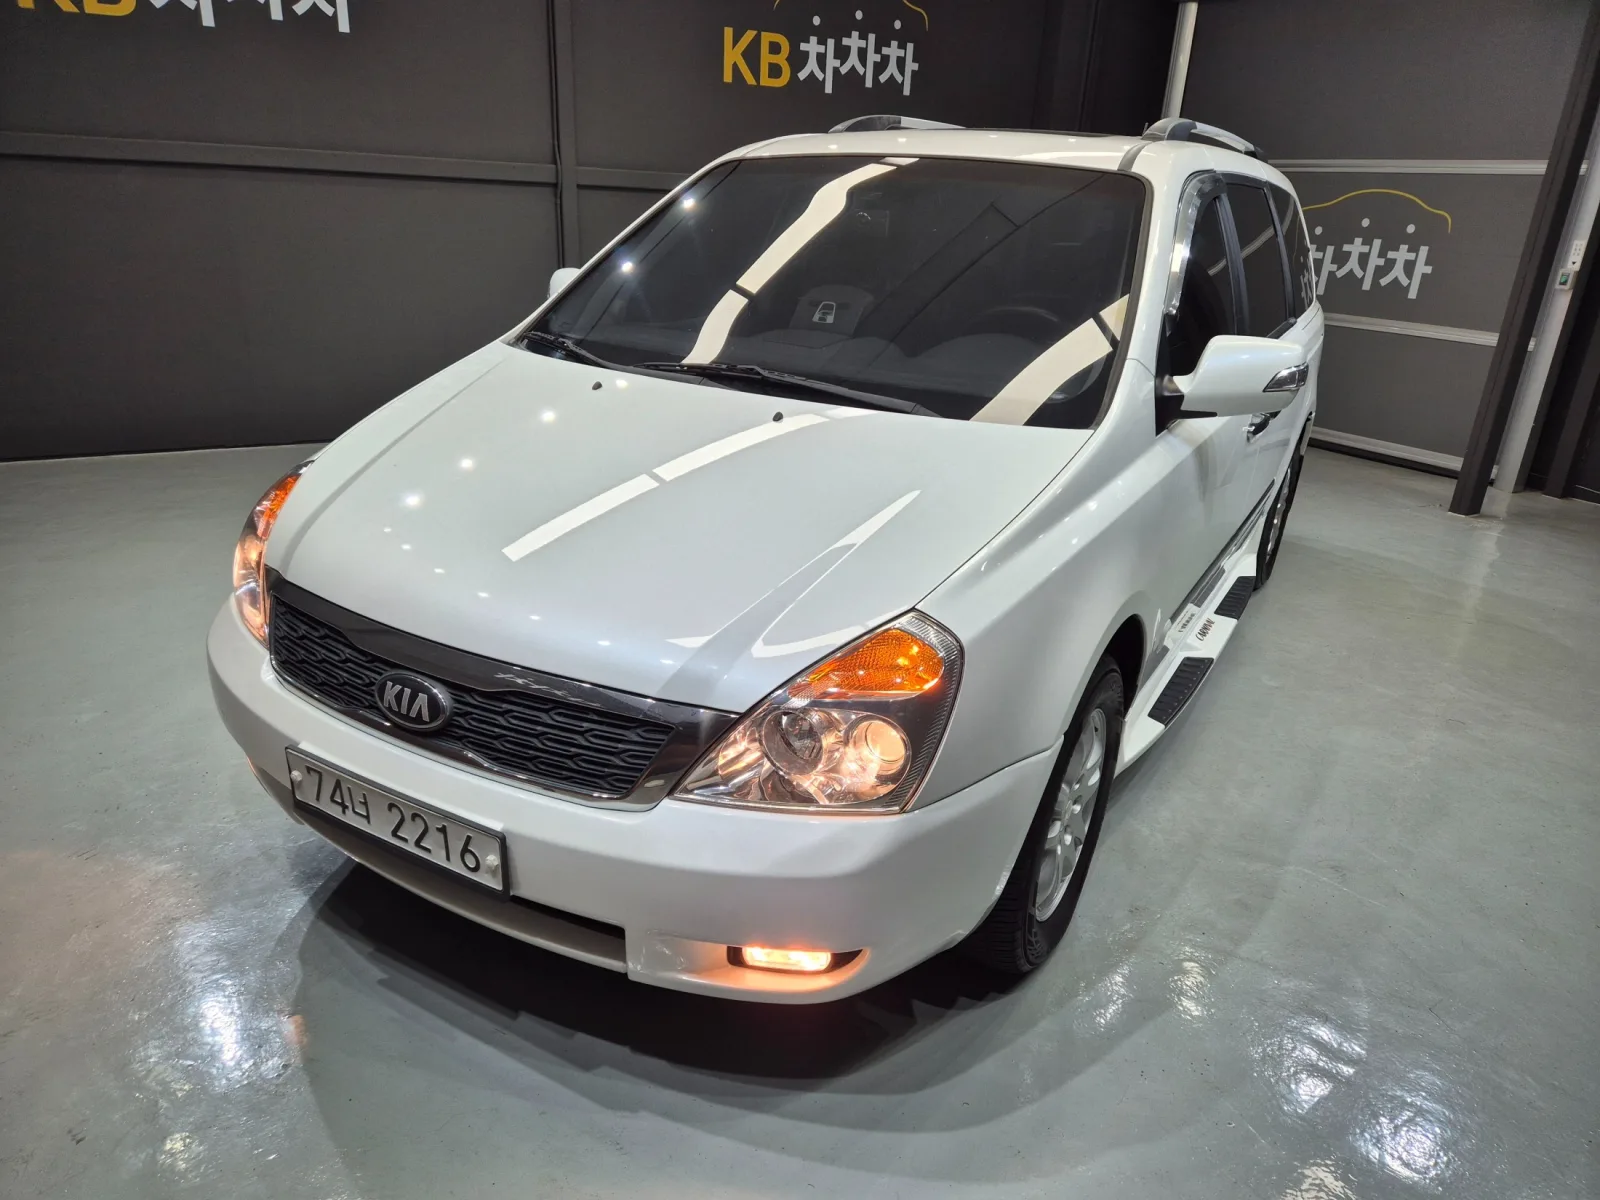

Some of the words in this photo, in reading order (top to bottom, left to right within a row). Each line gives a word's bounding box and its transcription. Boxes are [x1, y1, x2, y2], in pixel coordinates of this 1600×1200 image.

[383, 681, 430, 722] KIA
[306, 764, 371, 825] 74너
[387, 802, 481, 873] 2216
